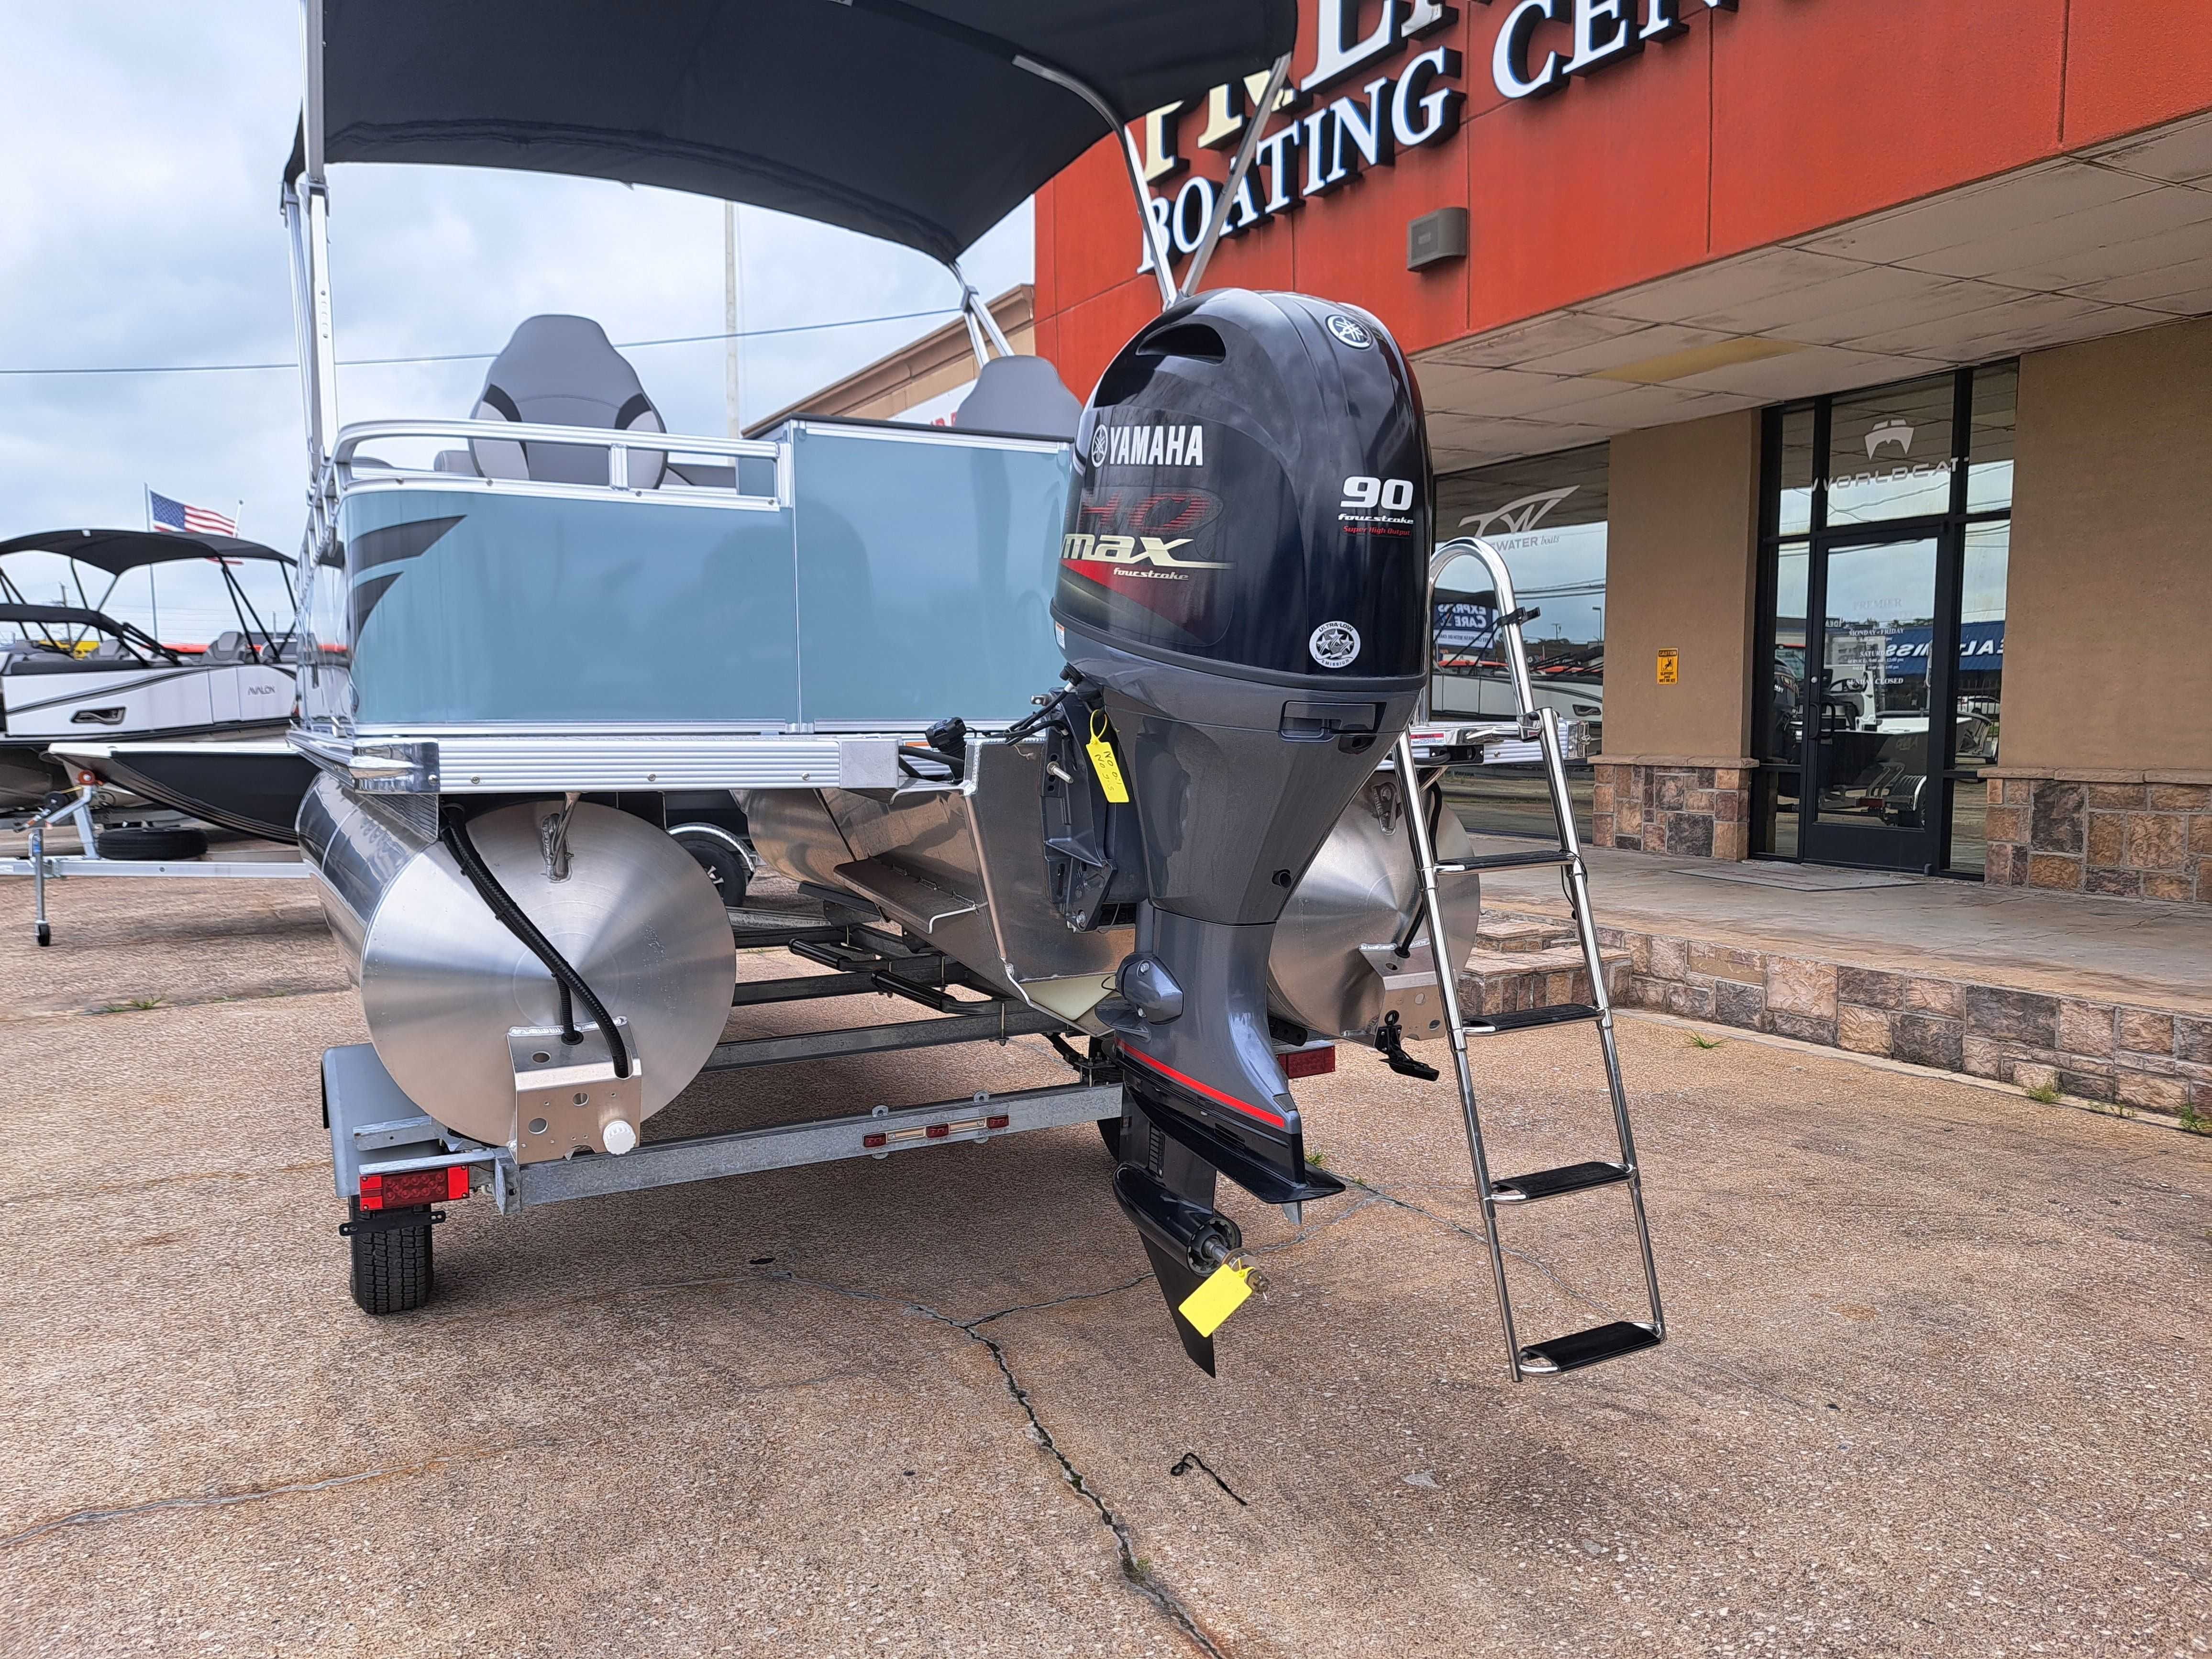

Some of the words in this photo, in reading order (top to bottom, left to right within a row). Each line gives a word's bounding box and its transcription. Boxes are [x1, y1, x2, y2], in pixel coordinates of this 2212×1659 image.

[1109, 425, 1203, 466] YAMAHA
[1340, 476, 1413, 510] 90
[1343, 525, 1367, 534] Super
[1369, 527, 1386, 536] High
[1387, 528, 1411, 536] Output
[1540, 535, 1559, 546] boats
[1853, 598, 1902, 610] PREMIER
[1875, 677, 1904, 686] CLOSED
[248, 685, 276, 695] AVALON
